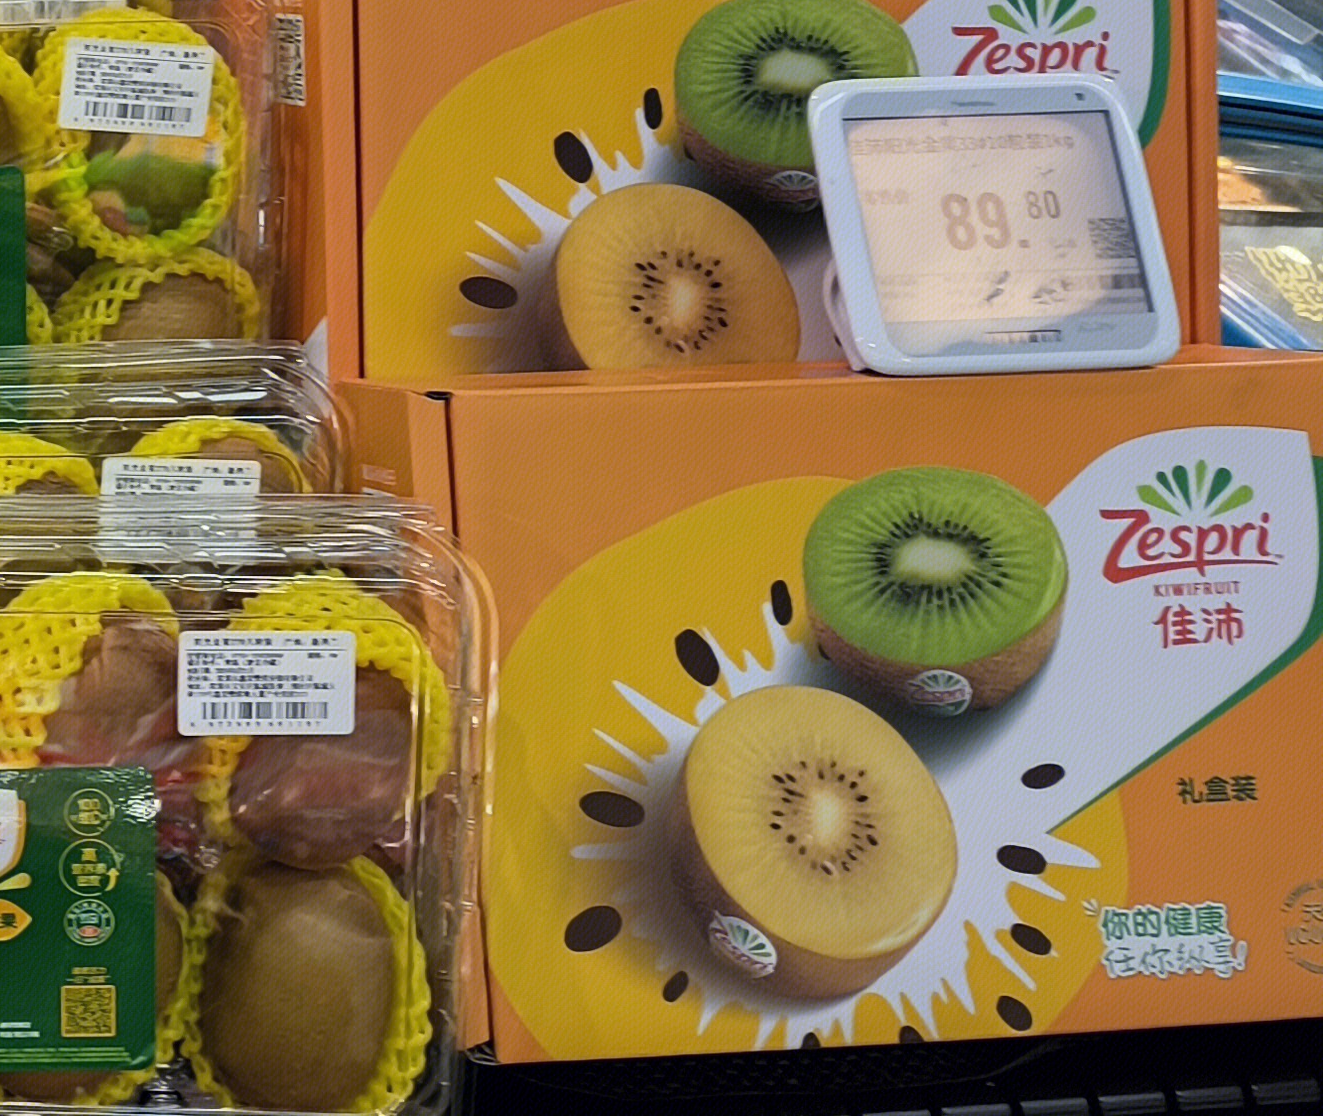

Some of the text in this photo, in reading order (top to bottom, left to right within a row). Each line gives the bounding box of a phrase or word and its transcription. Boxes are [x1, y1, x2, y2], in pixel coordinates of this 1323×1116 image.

[951, 26, 1119, 78] Zespri
[1099, 509, 1284, 585] Zespri
[1153, 582, 1241, 597] KIWIFRUIT
[1152, 602, 1246, 649] 佳沛
[1178, 776, 1258, 805] 礼盒装
[1102, 905, 1226, 941] 你的健康
